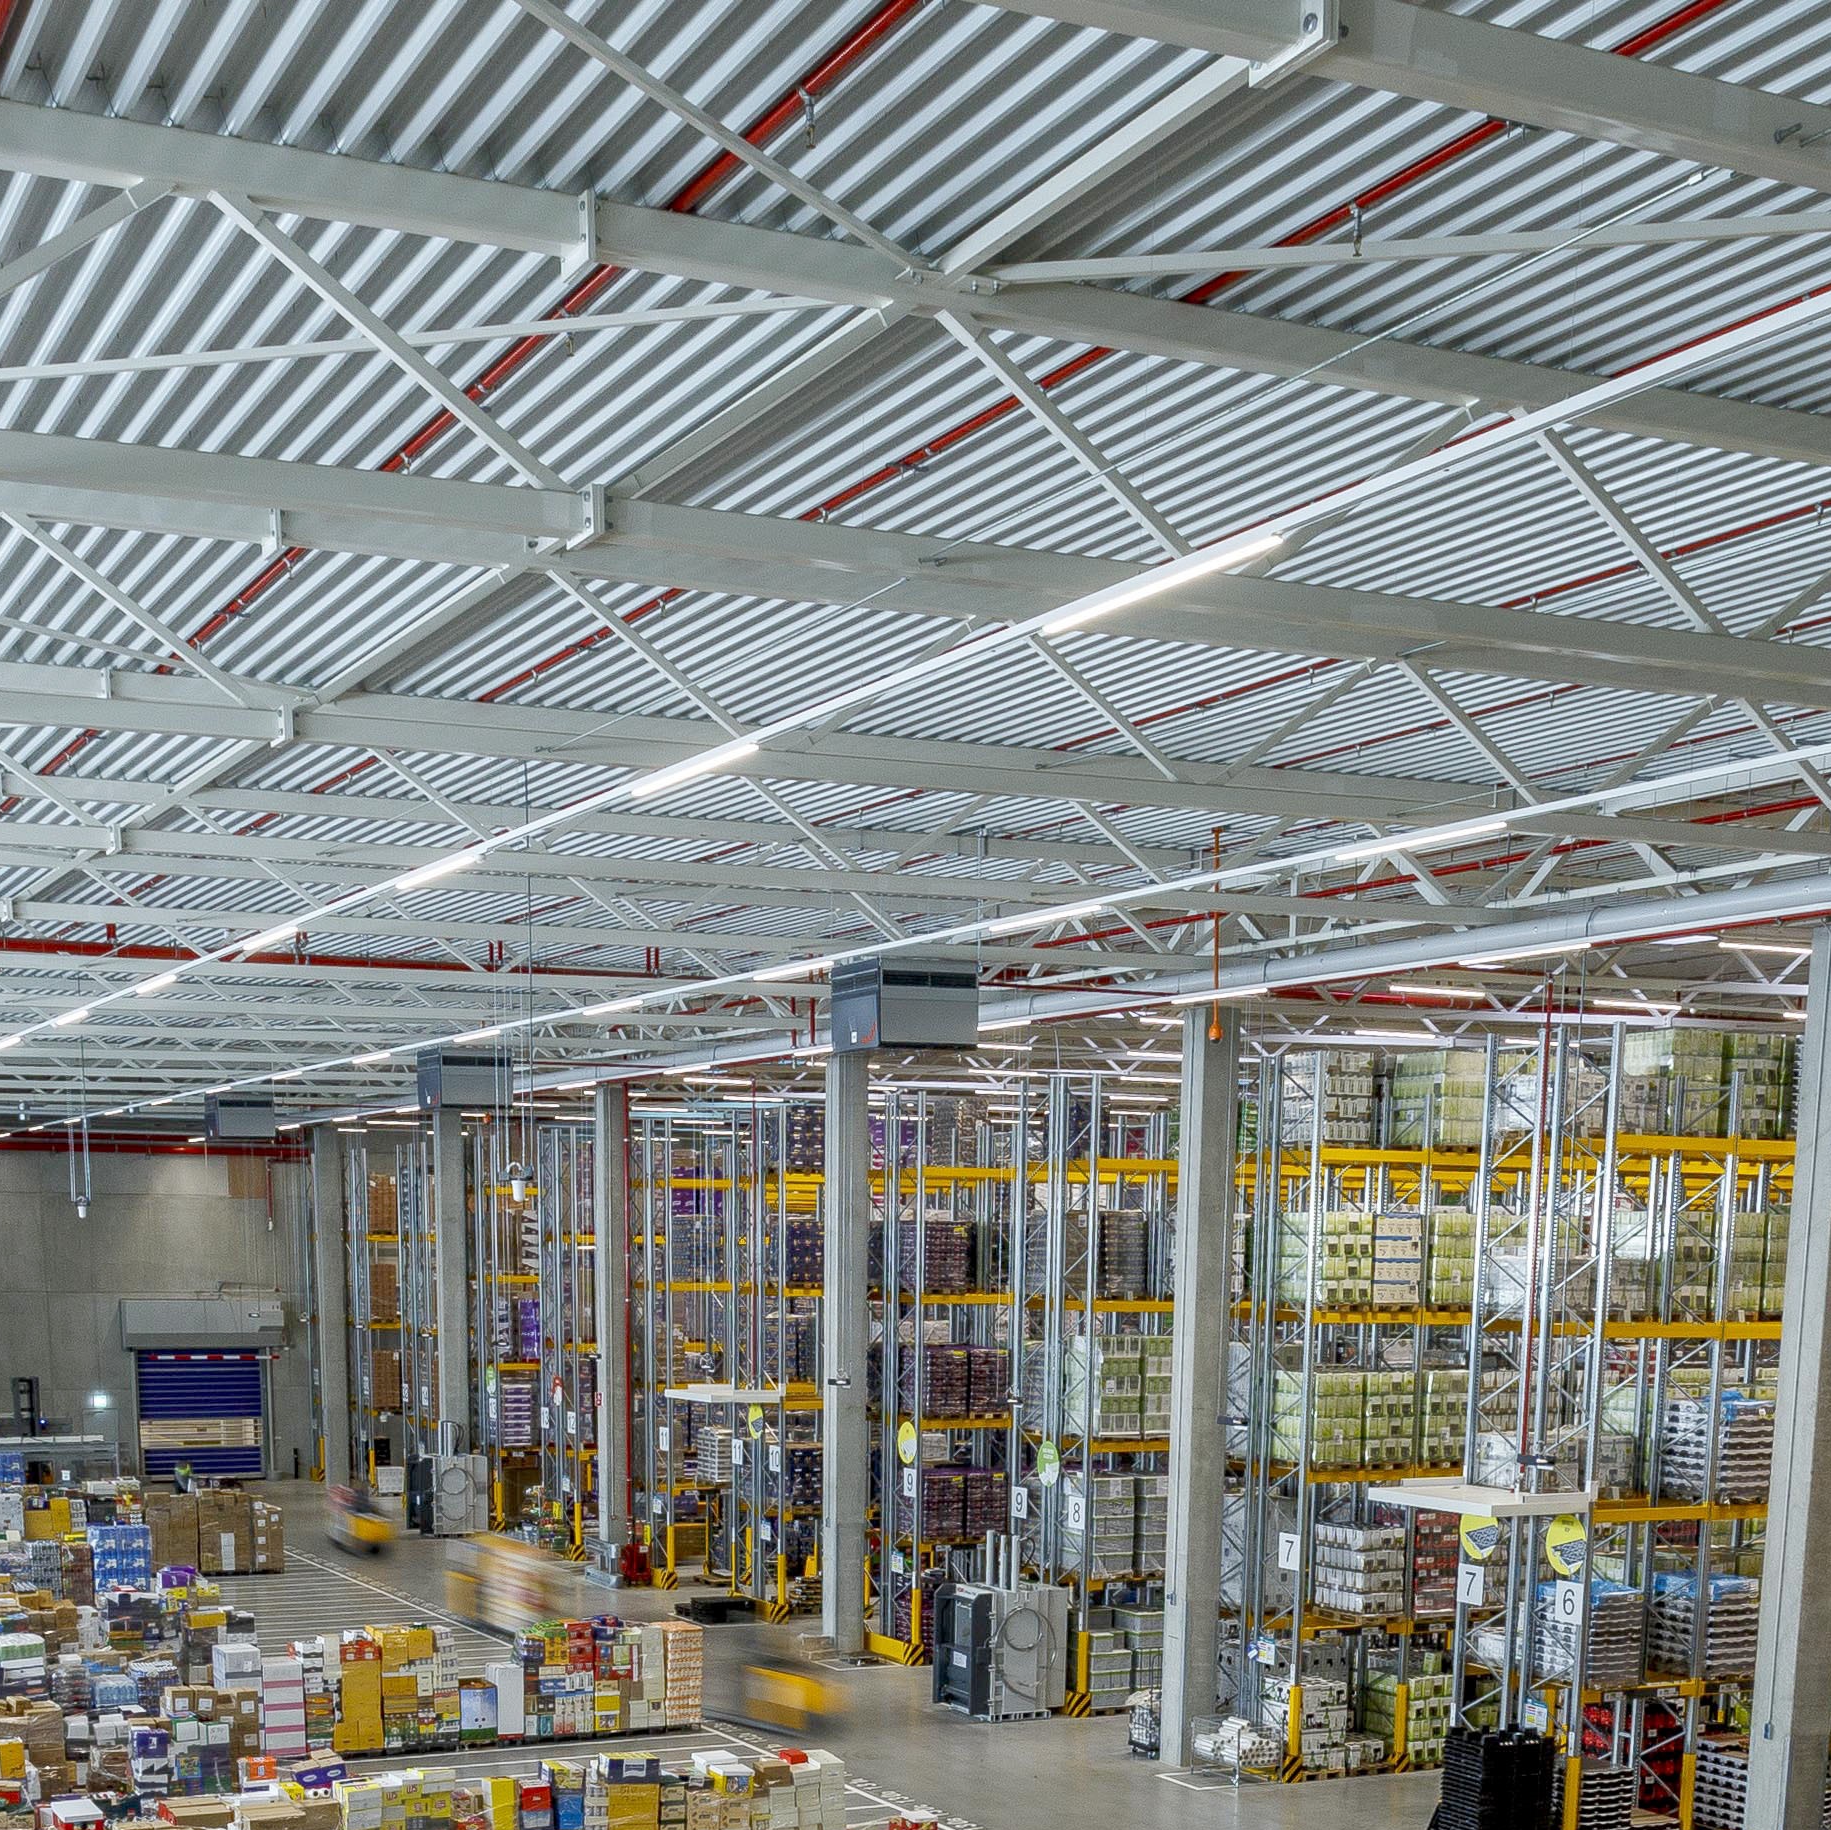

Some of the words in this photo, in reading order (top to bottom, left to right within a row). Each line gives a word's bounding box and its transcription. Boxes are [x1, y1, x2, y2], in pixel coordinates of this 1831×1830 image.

[770, 1450, 779, 1468] 10
[906, 1472, 914, 1490] 9
[1015, 1492, 1024, 1510] 9
[1072, 1502, 1080, 1523] 8
[1284, 1540, 1294, 1562] 7
[1466, 1571, 1476, 1596] 7
[1562, 1588, 1575, 1616] 6
